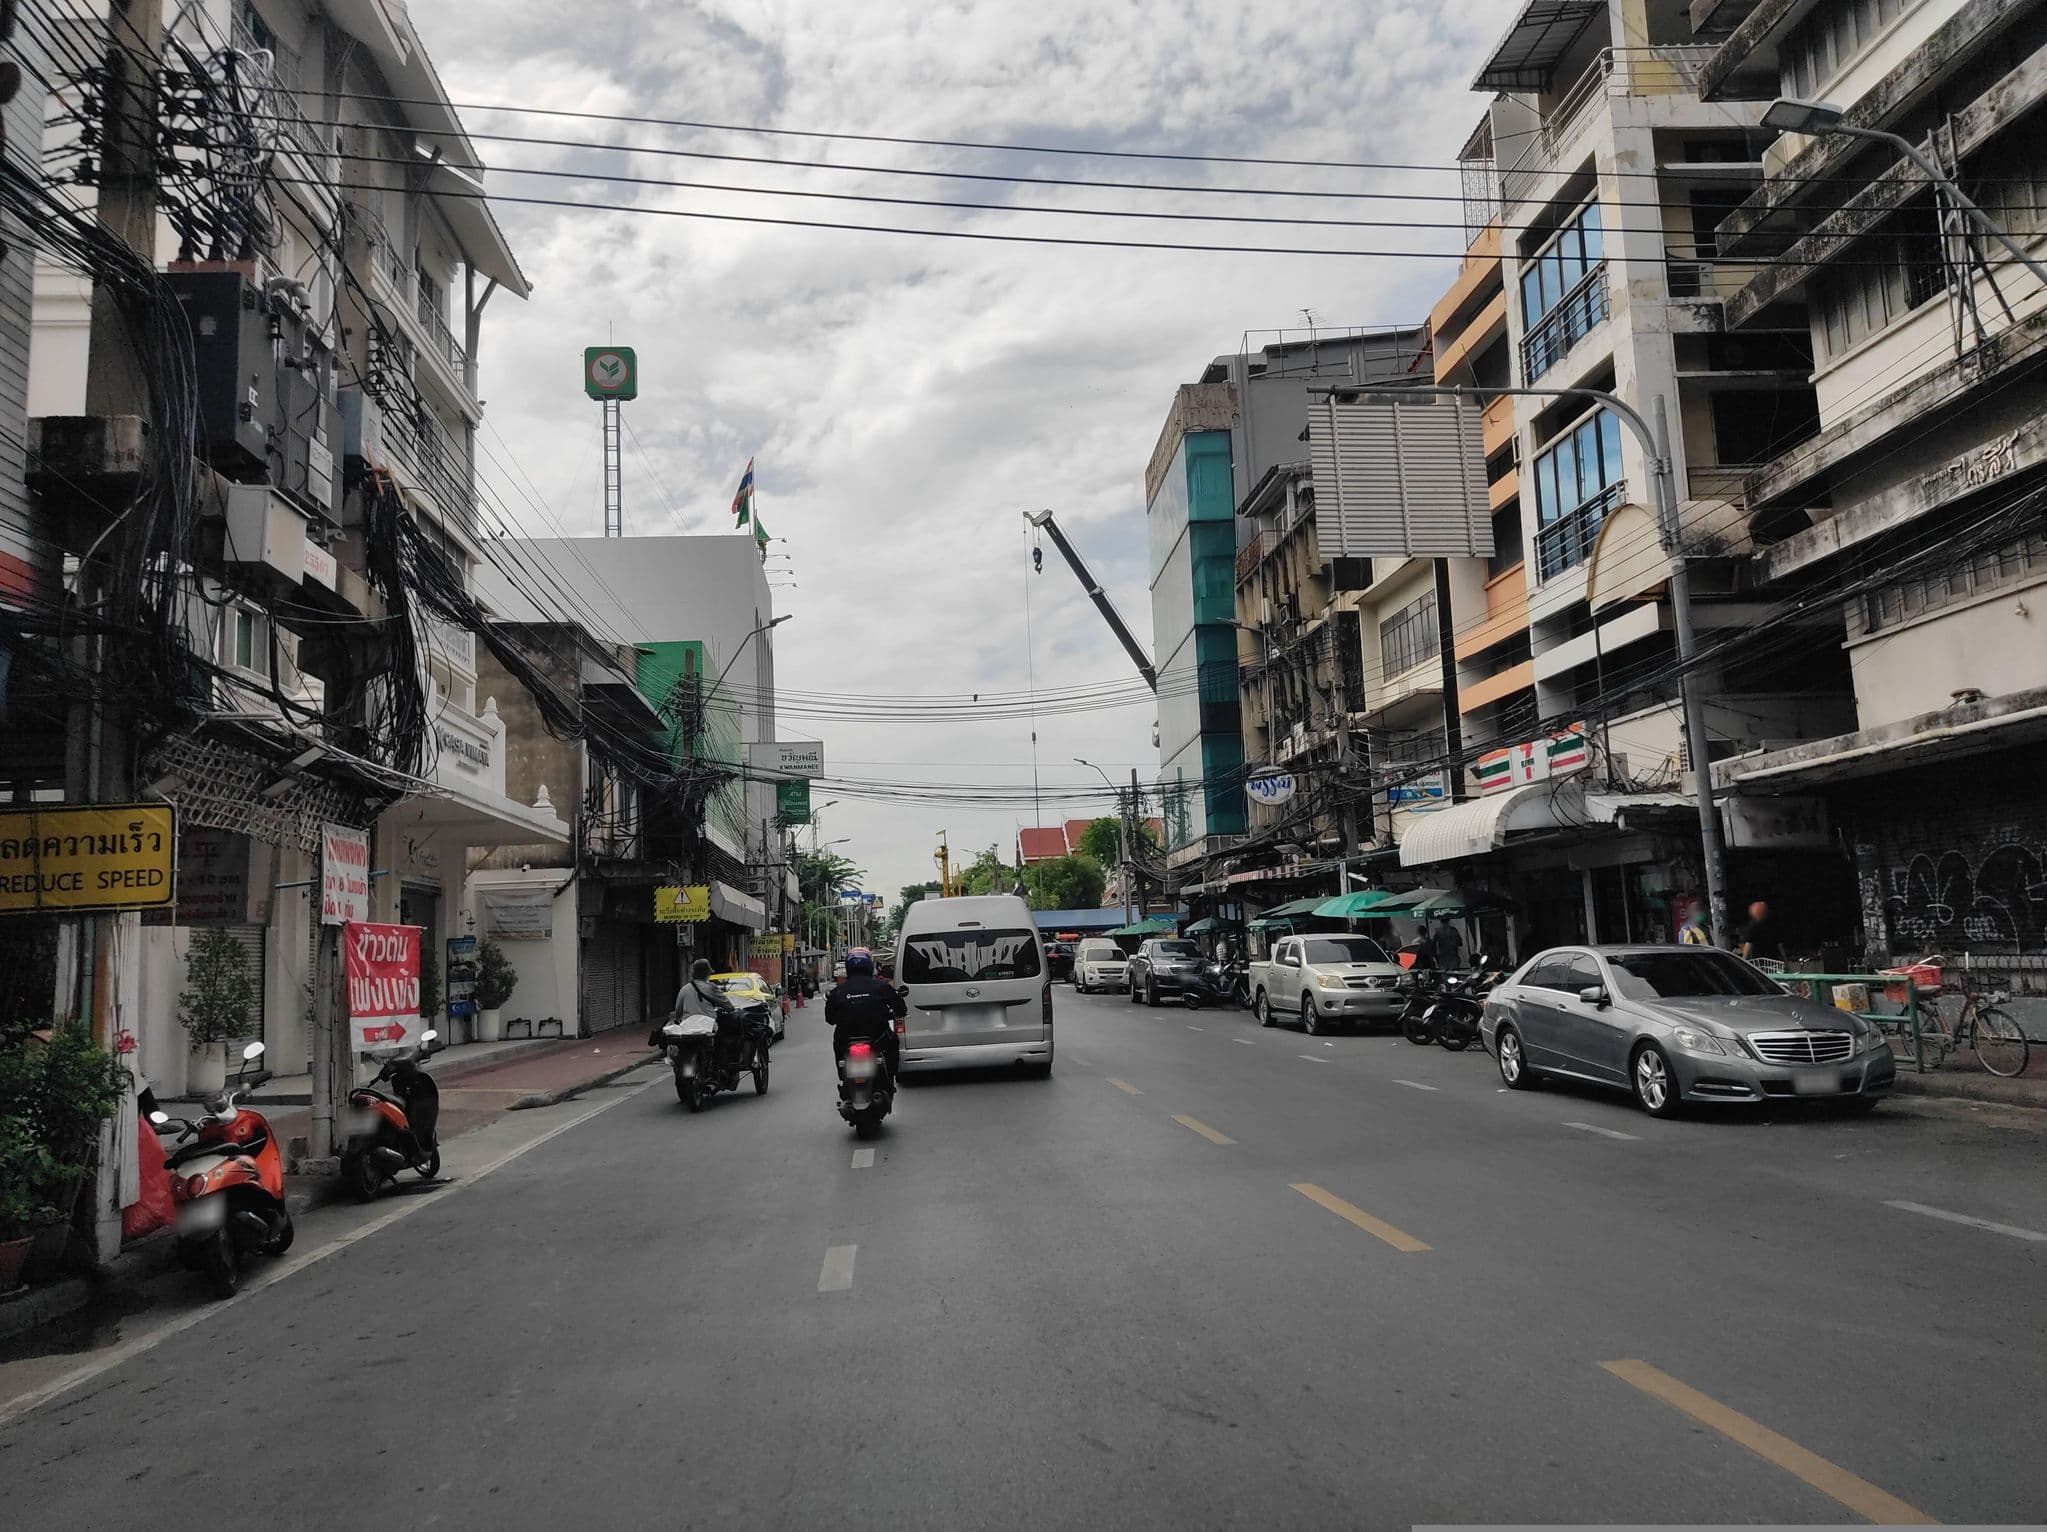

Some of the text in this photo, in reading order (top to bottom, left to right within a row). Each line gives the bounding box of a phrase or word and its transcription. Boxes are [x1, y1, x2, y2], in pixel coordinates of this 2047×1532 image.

[0, 821, 161, 860] ลดความเร็ว
[0, 872, 84, 894] REDUCE
[97, 869, 163, 889] SPEED
[357, 926, 409, 962] ข้าวต้ม
[907, 936, 1032, 978] THAWAT
